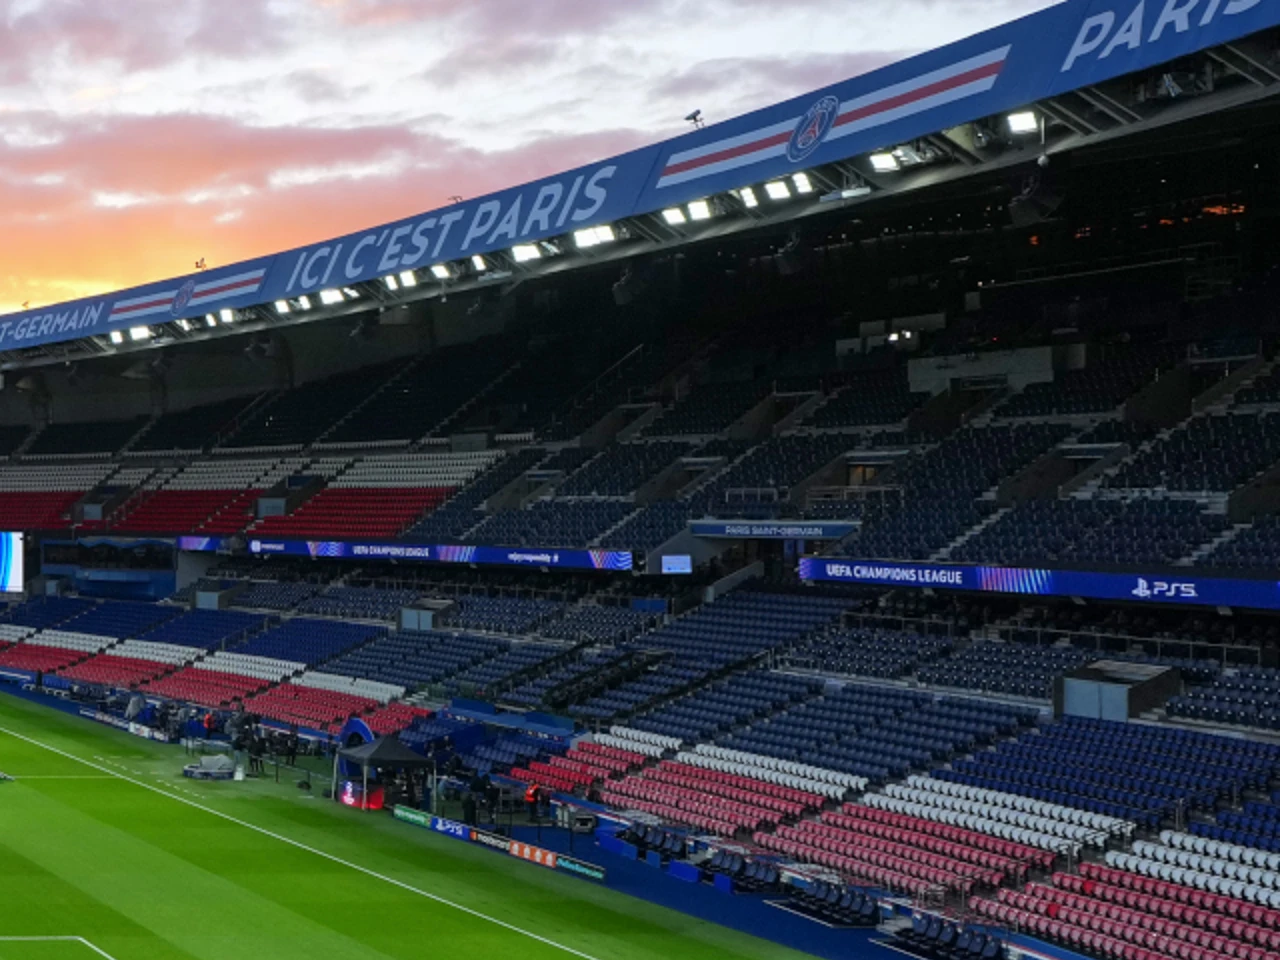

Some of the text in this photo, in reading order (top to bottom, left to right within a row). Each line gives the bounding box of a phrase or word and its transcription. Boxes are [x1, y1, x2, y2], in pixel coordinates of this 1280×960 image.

[1060, 0, 1262, 73] PAR
[285, 165, 617, 292] ICI C'EST PARIS
[826, 564, 963, 585] UEFA CHAMPIONS LEAGUE
[1153, 581, 1197, 597] PS5
